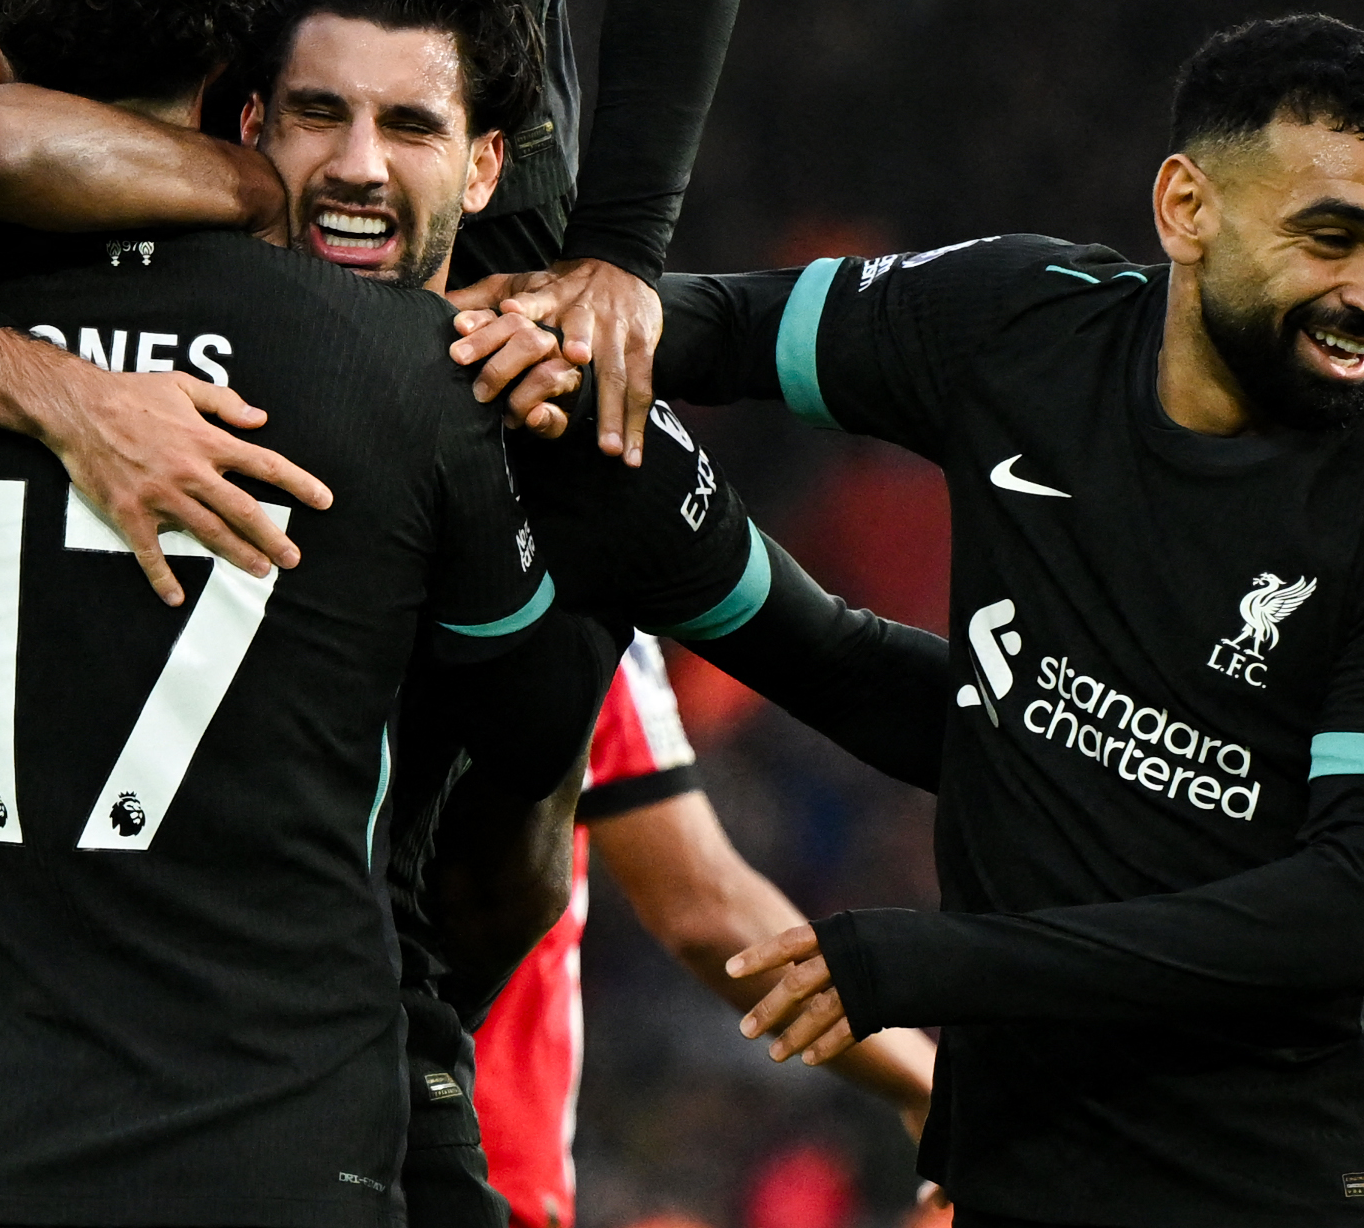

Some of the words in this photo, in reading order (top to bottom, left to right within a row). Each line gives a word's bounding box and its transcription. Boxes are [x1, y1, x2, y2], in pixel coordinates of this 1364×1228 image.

[28, 324, 233, 388] NES
[680, 445, 717, 532] Exp
[1207, 644, 1267, 689] L.F.C.
[1023, 699, 1262, 821] chartered
